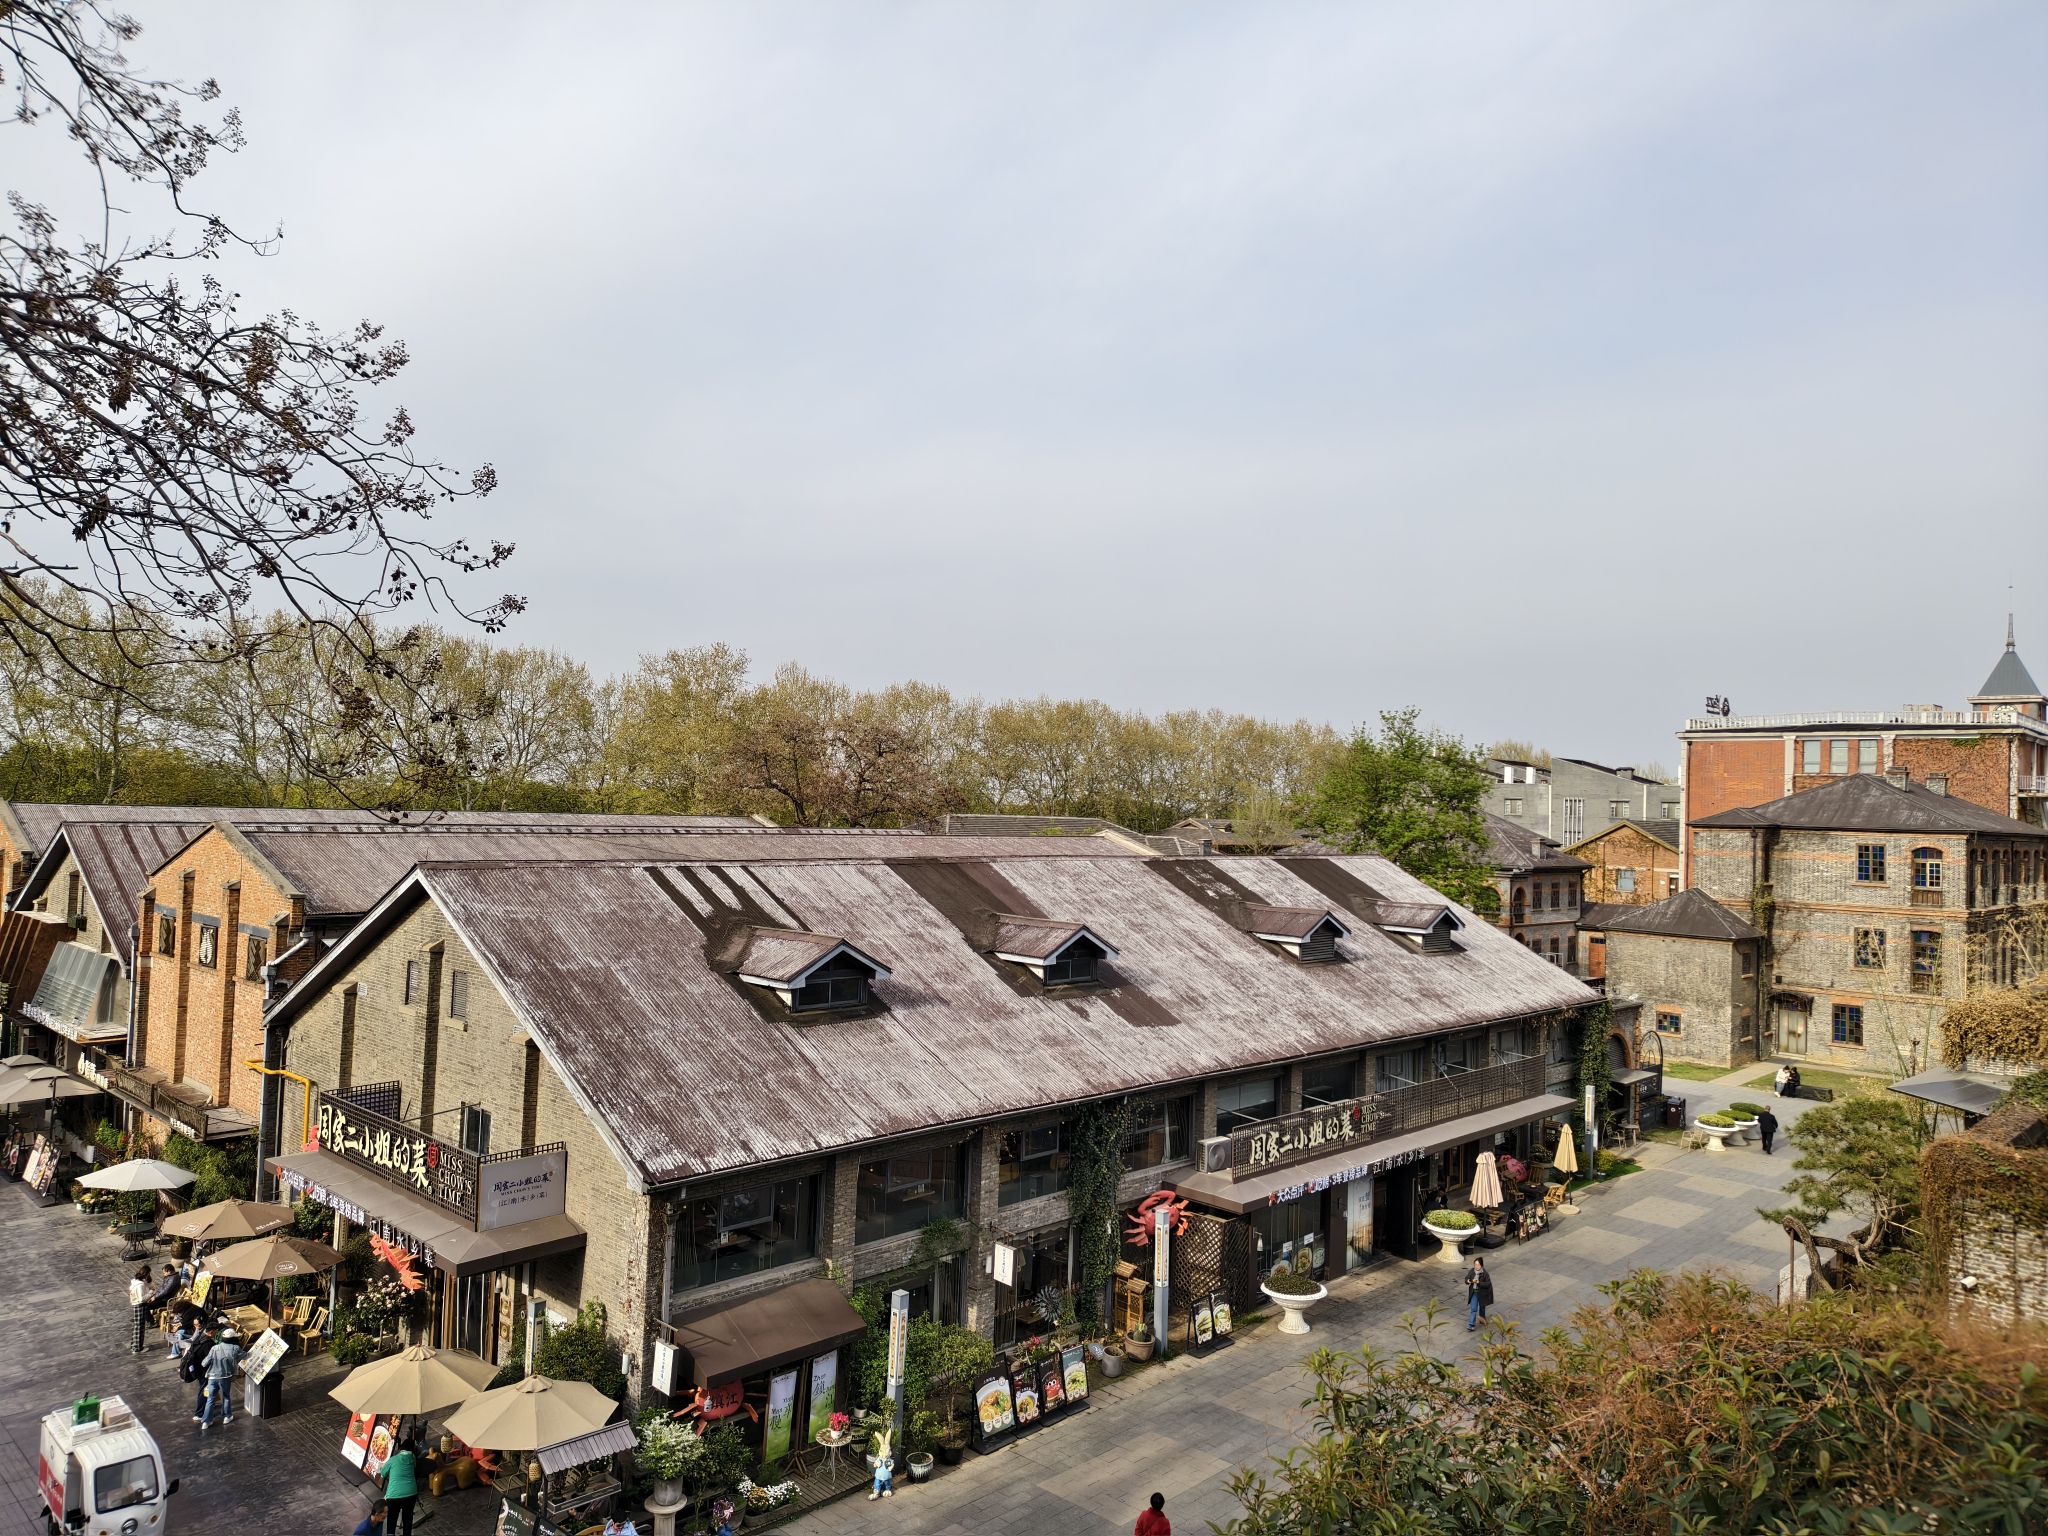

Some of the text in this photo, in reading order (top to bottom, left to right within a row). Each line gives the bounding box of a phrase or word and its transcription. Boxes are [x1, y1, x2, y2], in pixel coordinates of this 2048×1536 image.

[1361, 1102, 1377, 1114] MISS
[1250, 1109, 1354, 1166] 周家二小姐的菜
[1361, 1121, 1377, 1133] TIME
[318, 1105, 430, 1189] 周家二小姐的菜
[440, 1151, 463, 1173] MISS
[439, 1168, 472, 1194] CHOW'S
[439, 1183, 462, 1206] TIME
